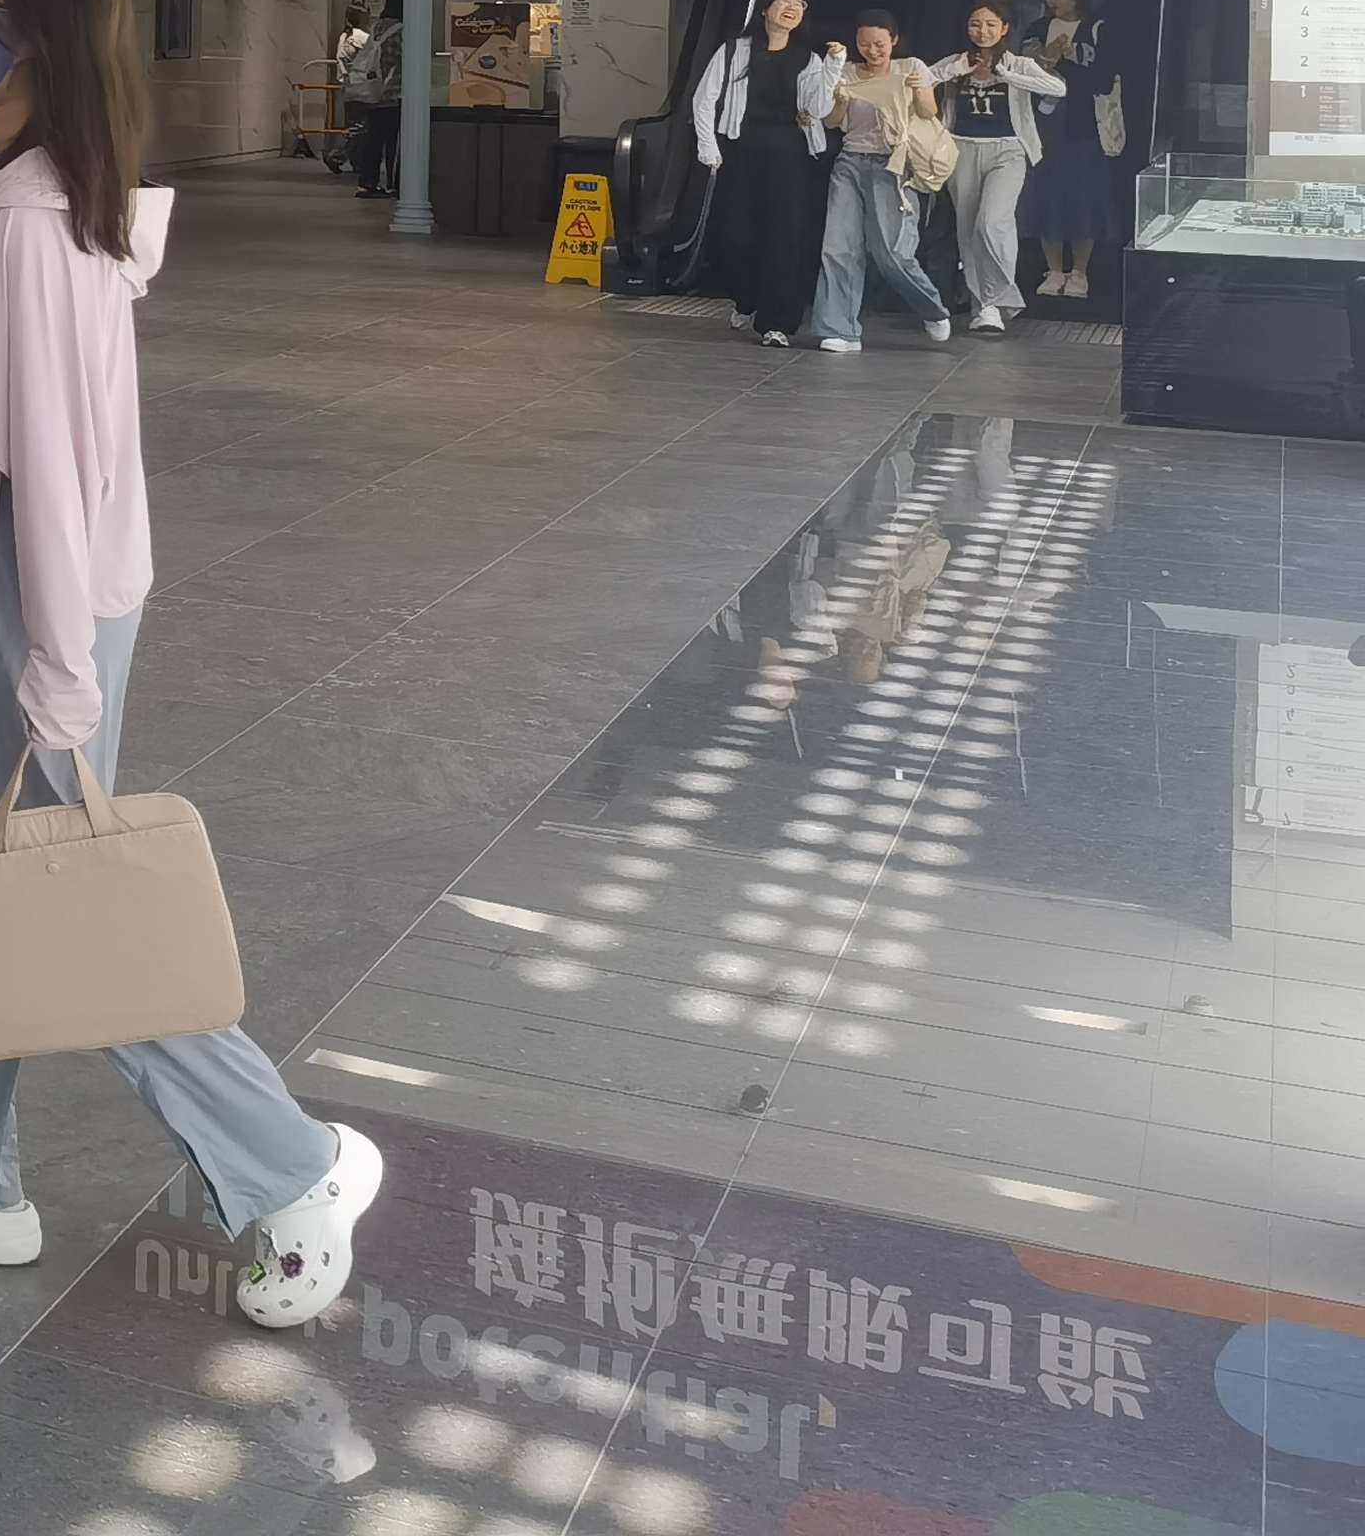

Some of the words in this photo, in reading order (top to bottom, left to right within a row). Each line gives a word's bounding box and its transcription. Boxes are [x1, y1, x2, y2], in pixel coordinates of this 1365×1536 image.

[1300, 5, 1309, 17] 4
[1300, 26, 1308, 38] 3
[1300, 55, 1308, 67] 2
[1300, 84, 1306, 97] 1
